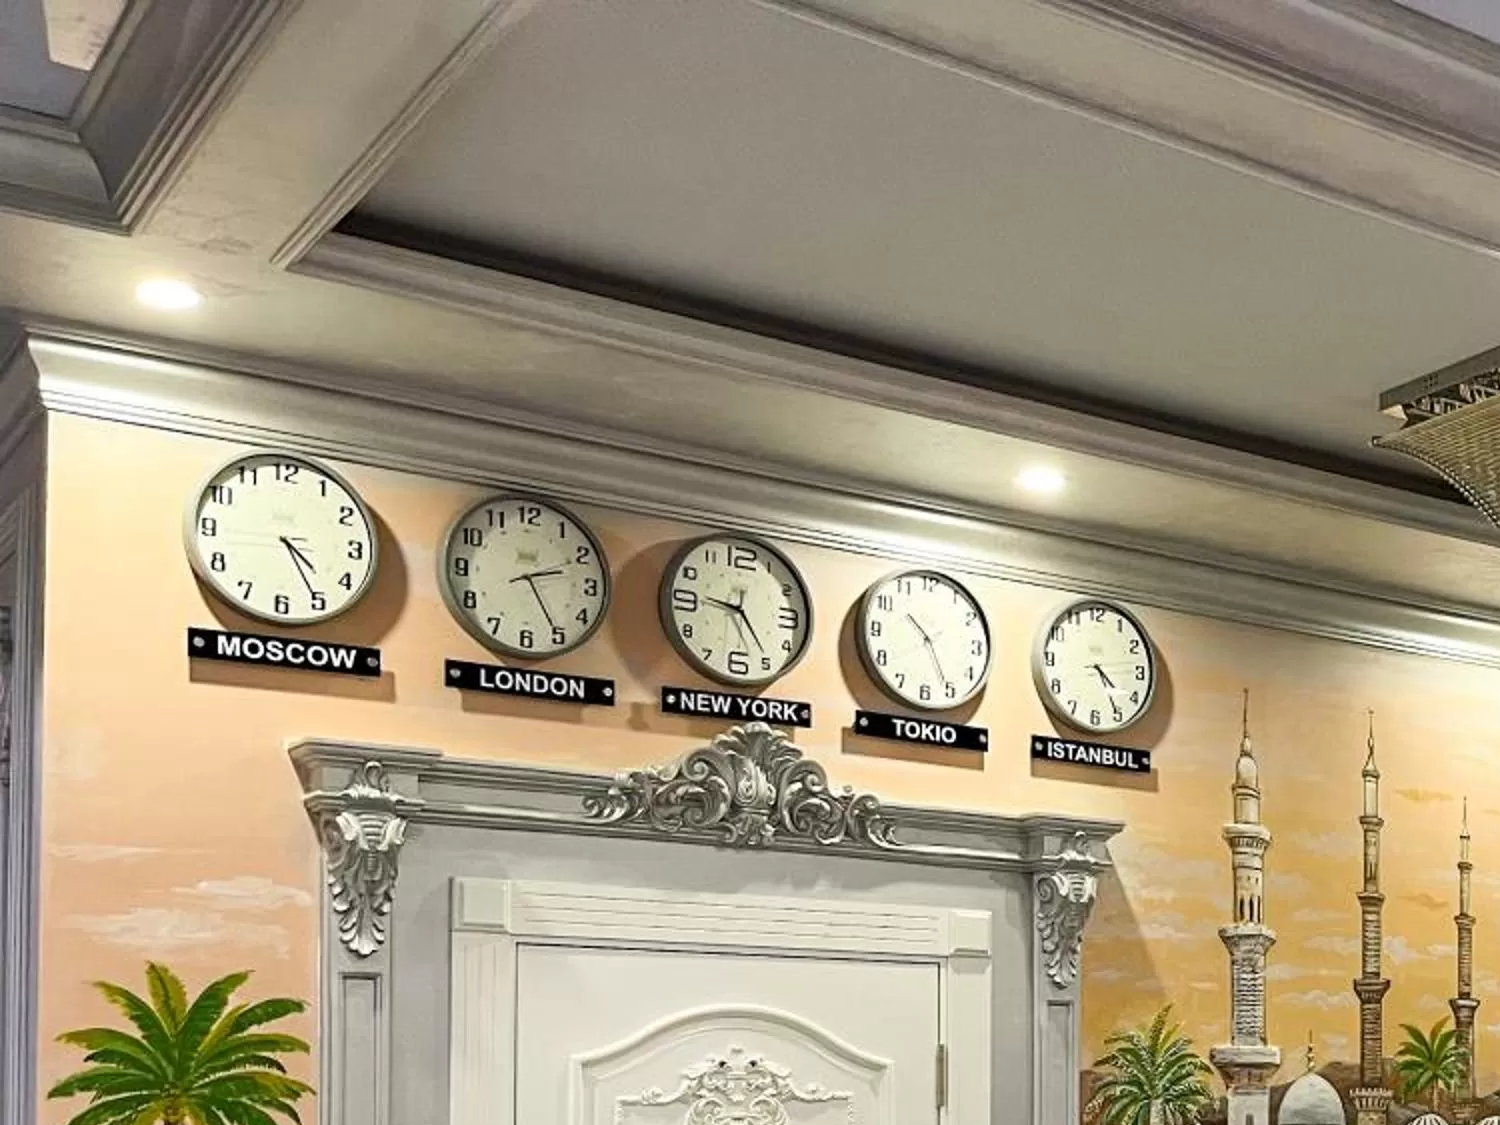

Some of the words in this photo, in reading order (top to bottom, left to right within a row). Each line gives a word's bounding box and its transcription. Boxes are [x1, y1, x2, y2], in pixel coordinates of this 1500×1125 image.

[238, 466, 256, 485] 11
[275, 463, 299, 484] 12
[319, 480, 326, 496] 1
[340, 506, 353, 526] 2
[486, 510, 504, 528] 11
[518, 507, 541, 526] 12
[202, 518, 216, 536] 9
[559, 522, 564, 538] 1
[463, 528, 482, 546] 10
[348, 540, 362, 560] 3
[576, 546, 589, 564] 2
[706, 549, 716, 563] 11
[728, 545, 756, 571] 12
[211, 552, 225, 572] 8
[455, 558, 468, 576] 9
[767, 562, 770, 573] 1
[238, 580, 252, 600] 7
[338, 572, 351, 590] 4
[584, 578, 597, 596] 3
[897, 580, 910, 595] 11
[275, 595, 289, 614] 6
[312, 591, 326, 611] 5
[464, 590, 476, 608] 8
[674, 589, 697, 612] 9
[576, 608, 588, 624] 4
[779, 607, 798, 629] 3
[1068, 610, 1080, 625] 11
[1090, 608, 1104, 623] 12
[488, 617, 500, 635] 7
[552, 626, 565, 644] 5
[683, 624, 692, 638] 8
[871, 621, 881, 636] 9
[520, 630, 533, 648] 6
[972, 640, 982, 656] 3
[1130, 640, 1139, 654] 2
[217, 634, 357, 669] MOSCOW
[703, 648, 711, 660] 7
[877, 650, 886, 666] 8
[728, 651, 748, 675] 6
[762, 658, 770, 670] 5
[896, 674, 904, 688] 7
[1136, 666, 1144, 680] 3
[479, 668, 585, 699] LONDON
[920, 684, 930, 700] 6
[945, 682, 955, 698] 5
[680, 691, 732, 715] NEW
[736, 697, 799, 721] YORK
[1068, 700, 1077, 715] 7
[1090, 710, 1100, 725] 6
[891, 718, 957, 744] TOKIO
[1047, 741, 1139, 769] ISTANBUL
